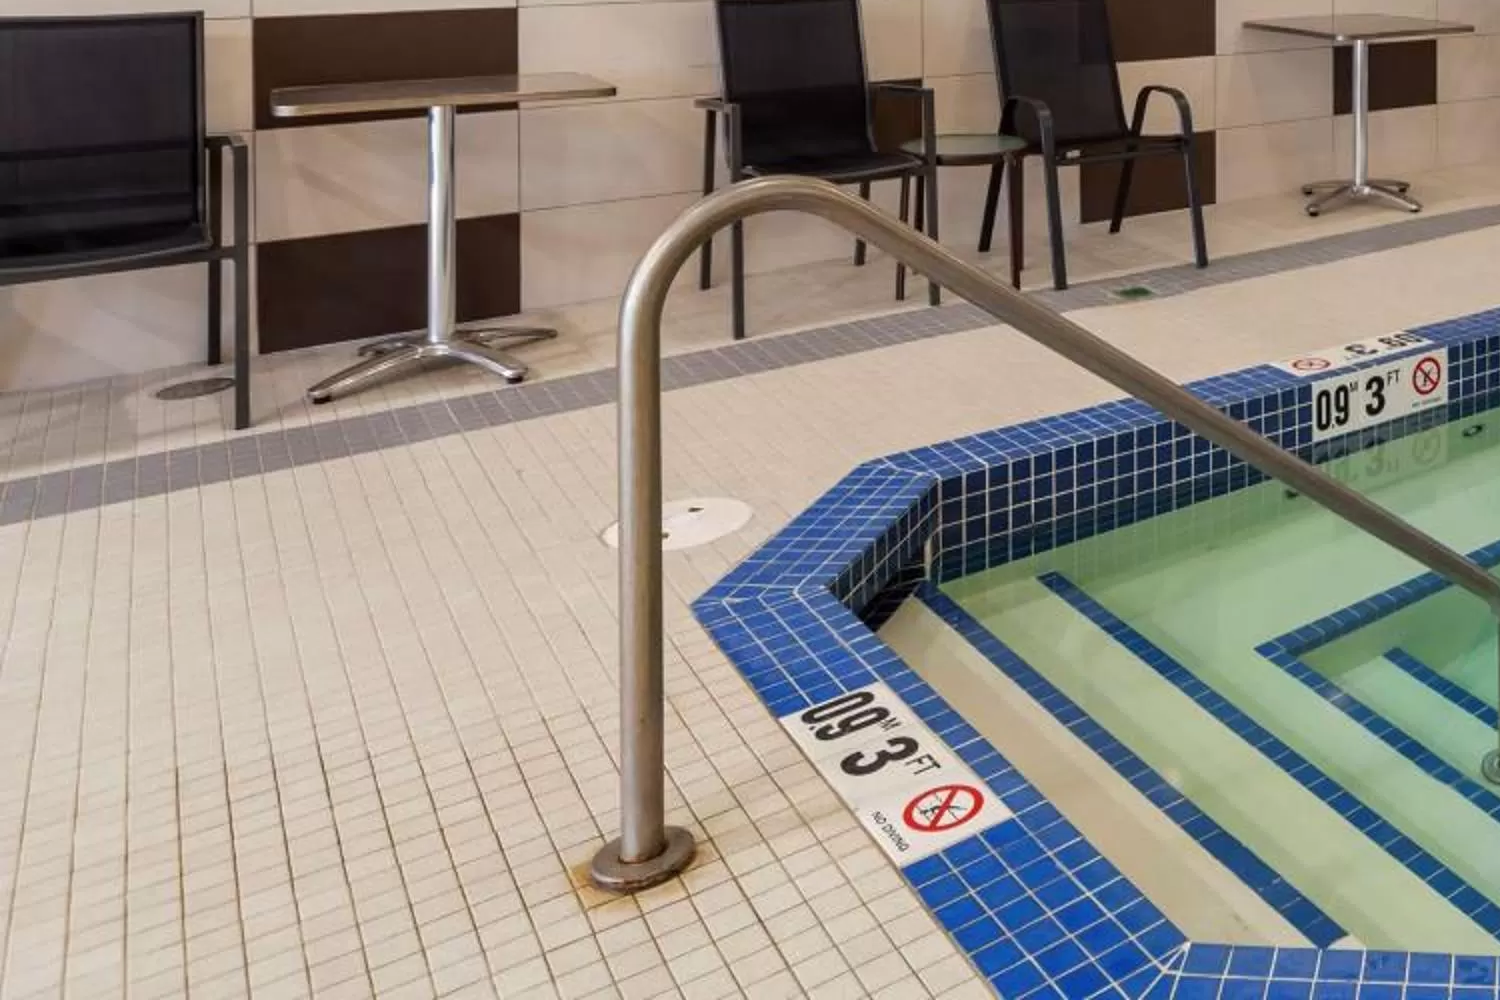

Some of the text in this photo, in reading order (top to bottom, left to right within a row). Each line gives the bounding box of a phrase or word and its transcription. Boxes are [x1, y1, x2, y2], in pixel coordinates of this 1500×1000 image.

[1365, 376, 1386, 416] 3
[1387, 369, 1400, 386] FT
[840, 736, 919, 777] 3
[904, 754, 941, 775] FT
